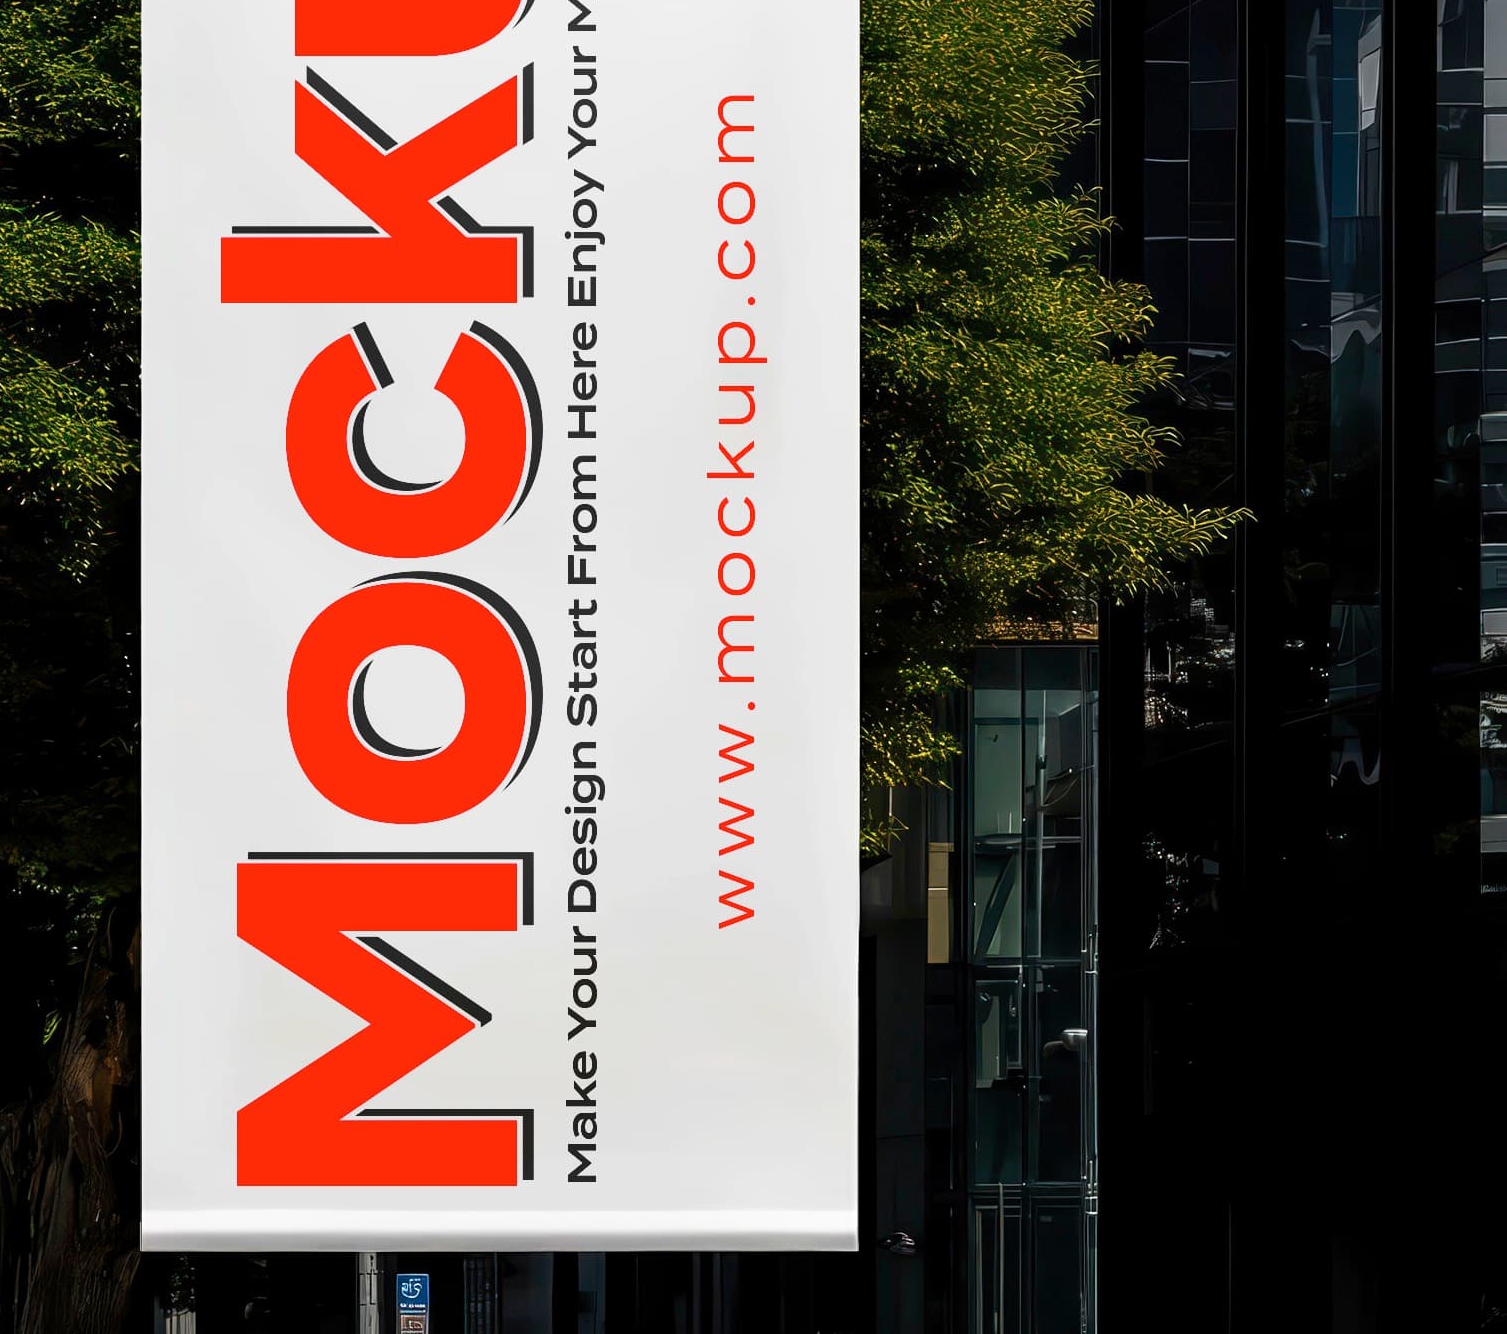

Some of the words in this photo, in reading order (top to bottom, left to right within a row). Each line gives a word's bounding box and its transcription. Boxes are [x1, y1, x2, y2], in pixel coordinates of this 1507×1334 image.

[567, 45, 598, 160] Your
[564, 168, 606, 307] Enjoy
[567, 321, 598, 439] Here
[567, 455, 598, 585] From
[706, 95, 768, 930] www.mockup.com
[566, 598, 598, 727] Start
[564, 741, 606, 913] Design
[567, 925, 598, 1042] Your
[565, 1050, 598, 1183] Make
